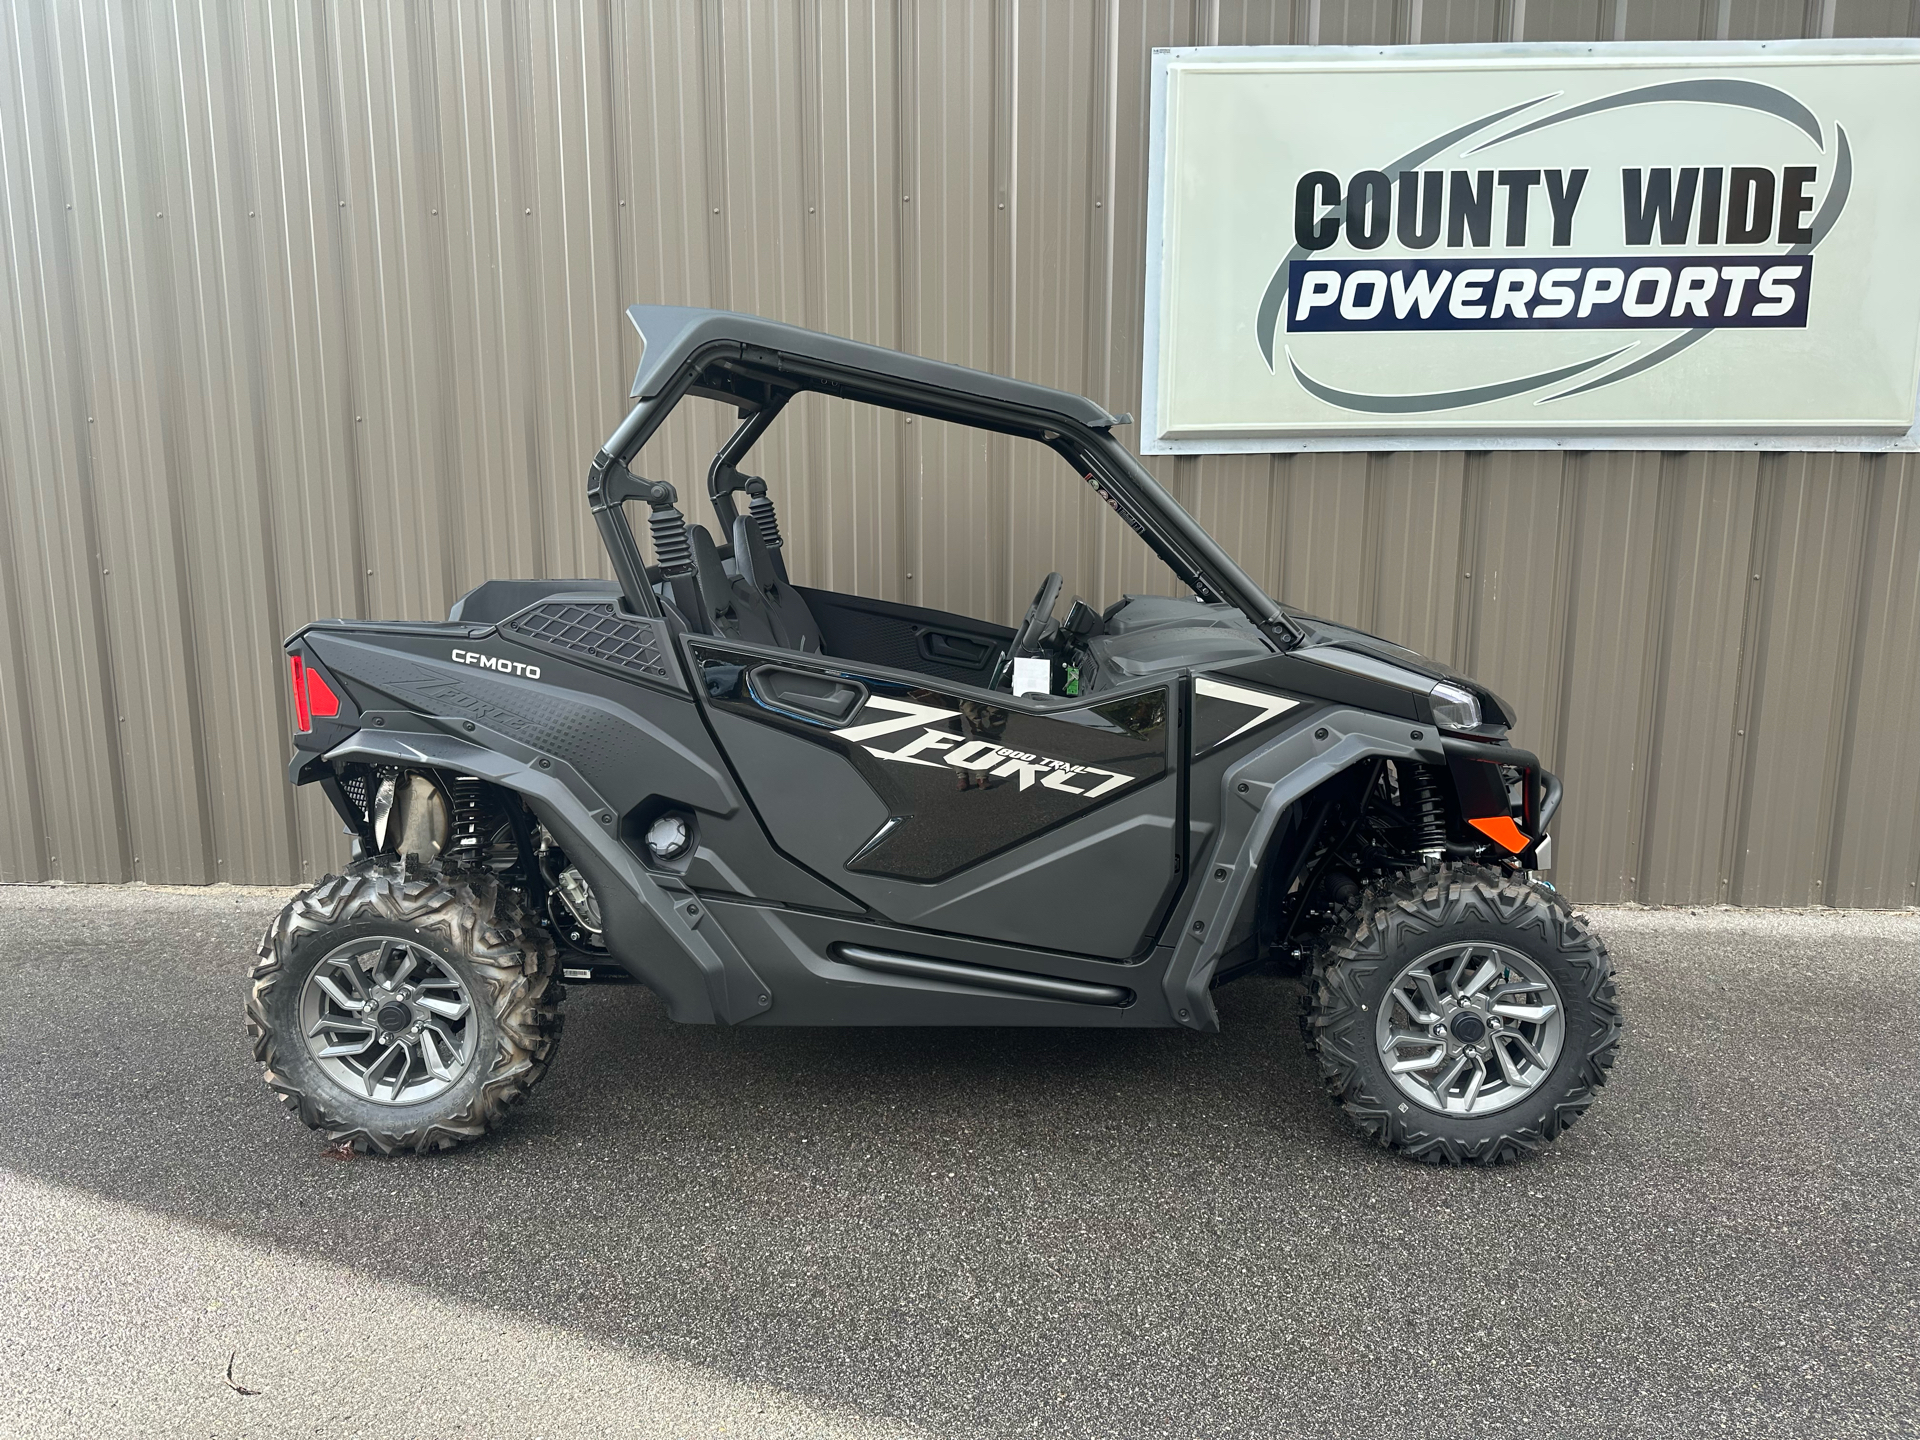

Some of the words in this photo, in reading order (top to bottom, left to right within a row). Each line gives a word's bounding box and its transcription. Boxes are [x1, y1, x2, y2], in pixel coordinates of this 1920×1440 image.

[1295, 169, 1589, 251] COUNTY
[1622, 166, 1817, 246] WIDE
[1295, 265, 1803, 321] POWERSPORTS
[452, 649, 541, 680] CFMOTO
[996, 748, 1037, 762] 800
[1040, 756, 1089, 775] TRAIL
